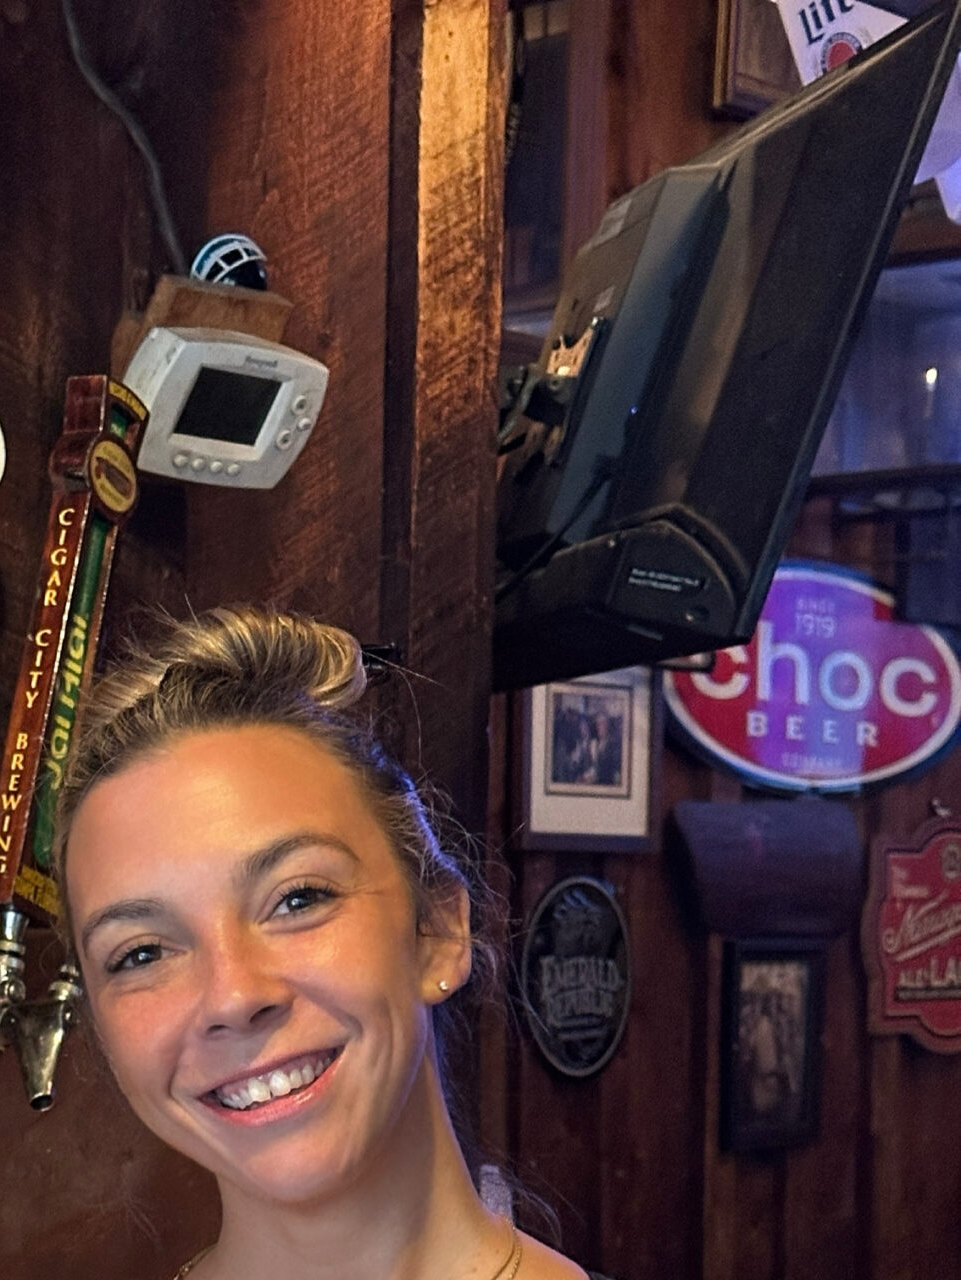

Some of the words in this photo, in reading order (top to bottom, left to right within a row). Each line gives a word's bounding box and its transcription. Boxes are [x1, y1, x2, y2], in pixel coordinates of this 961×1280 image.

[43, 507, 76, 607] CIGAR
[796, 613, 836, 639] 1919
[24, 628, 52, 709] CITY
[747, 710, 880, 748] BEER
